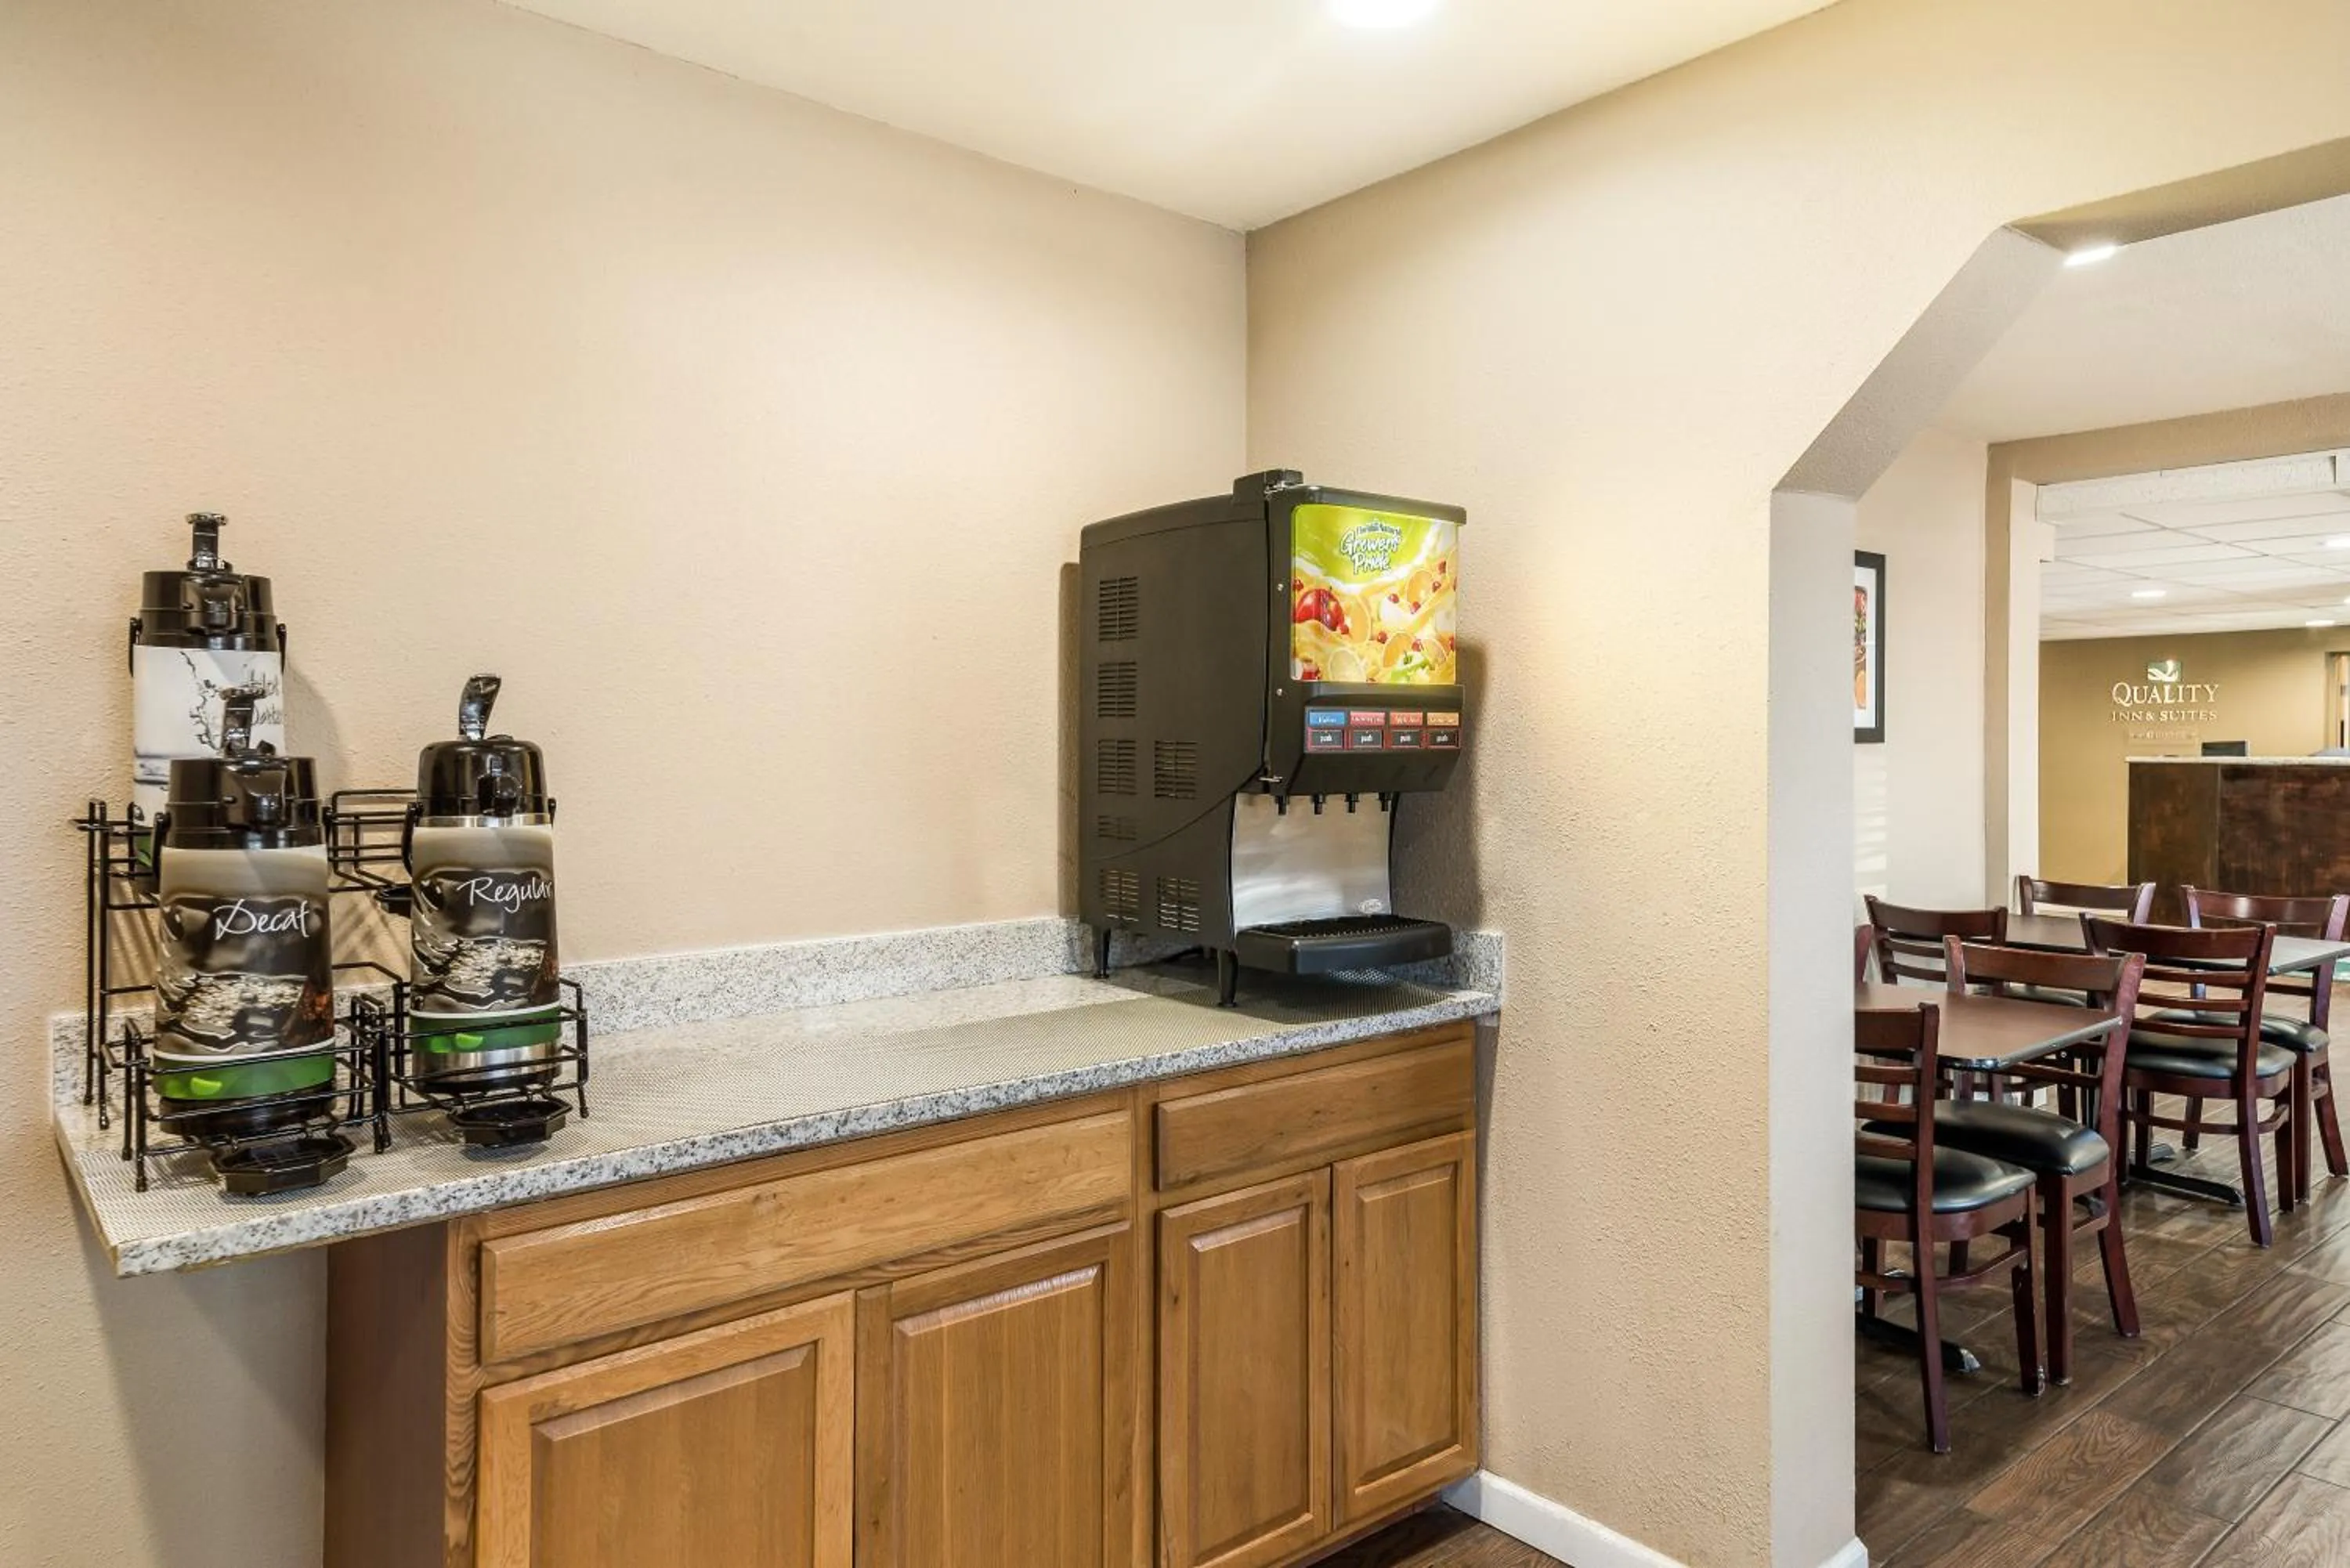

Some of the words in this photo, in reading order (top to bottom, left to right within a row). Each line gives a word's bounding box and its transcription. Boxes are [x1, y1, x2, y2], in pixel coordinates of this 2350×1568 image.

[2112, 681, 2219, 706] QUALITY
[2110, 710, 2144, 721] INN
[2159, 710, 2218, 721] SUITES
[456, 876, 552, 914] Regular
[212, 898, 310, 941] Decaf
